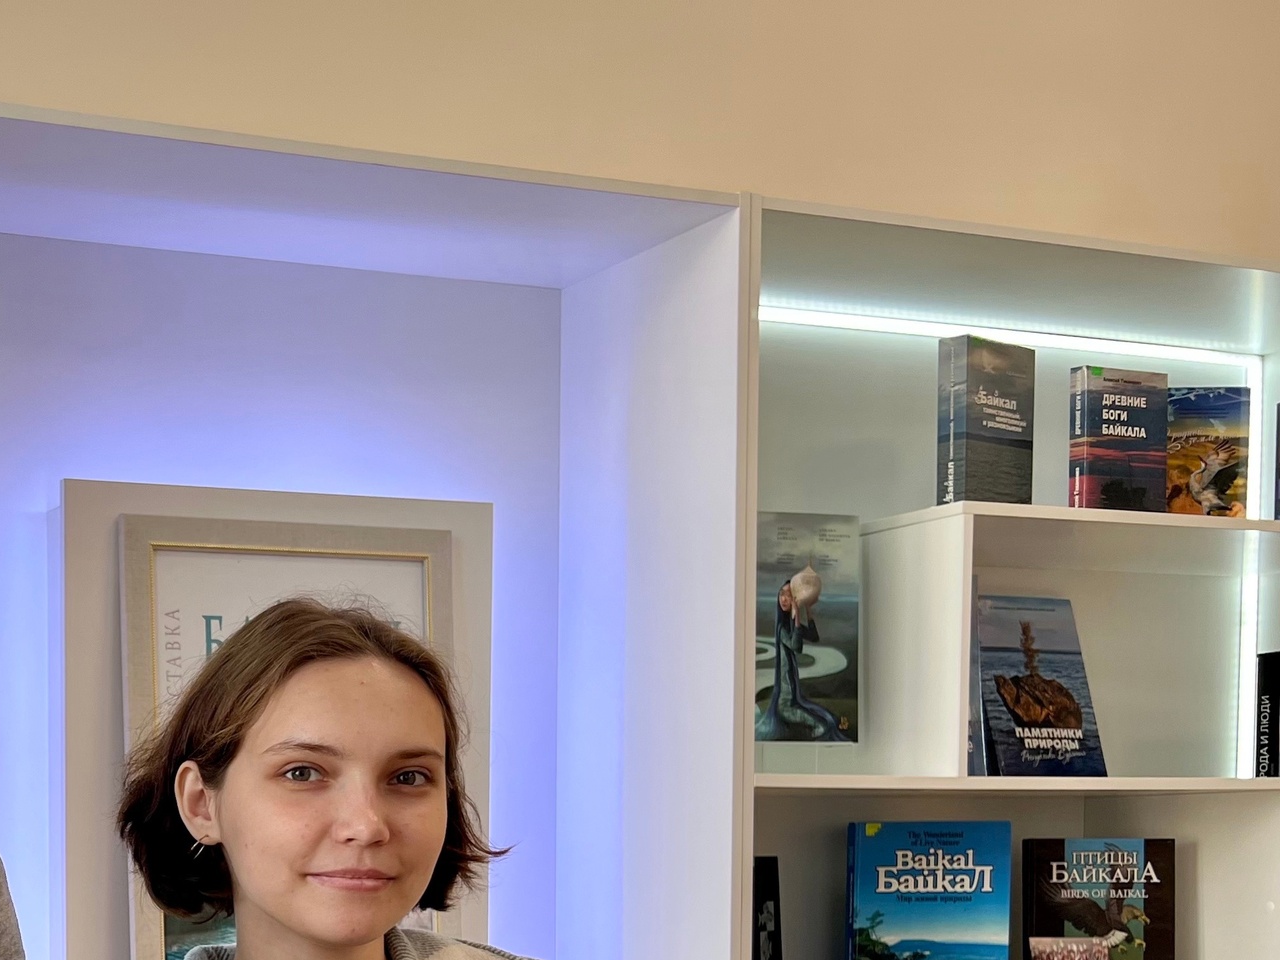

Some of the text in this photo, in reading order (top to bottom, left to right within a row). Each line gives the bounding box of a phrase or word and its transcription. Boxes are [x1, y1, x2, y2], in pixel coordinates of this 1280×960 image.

[1102, 394, 1147, 408] ДРЕВНИЕ
[1102, 409, 1128, 421] БОГИ
[1101, 422, 1147, 438] БАЙКАЛА
[164, 608, 183, 698] СТАВКА
[1260, 695, 1272, 733] ЛЮДИ
[1015, 727, 1083, 740] ПАМЯТНИКИ
[1023, 738, 1079, 752] ПРИРОДЫ
[895, 848, 975, 870] Baikal
[1072, 852, 1138, 866] ПТИЦЫ
[1050, 861, 1161, 884] БАЙКАЛА
[1060, 888, 1148, 898] BIRDS OF BAIKAL
